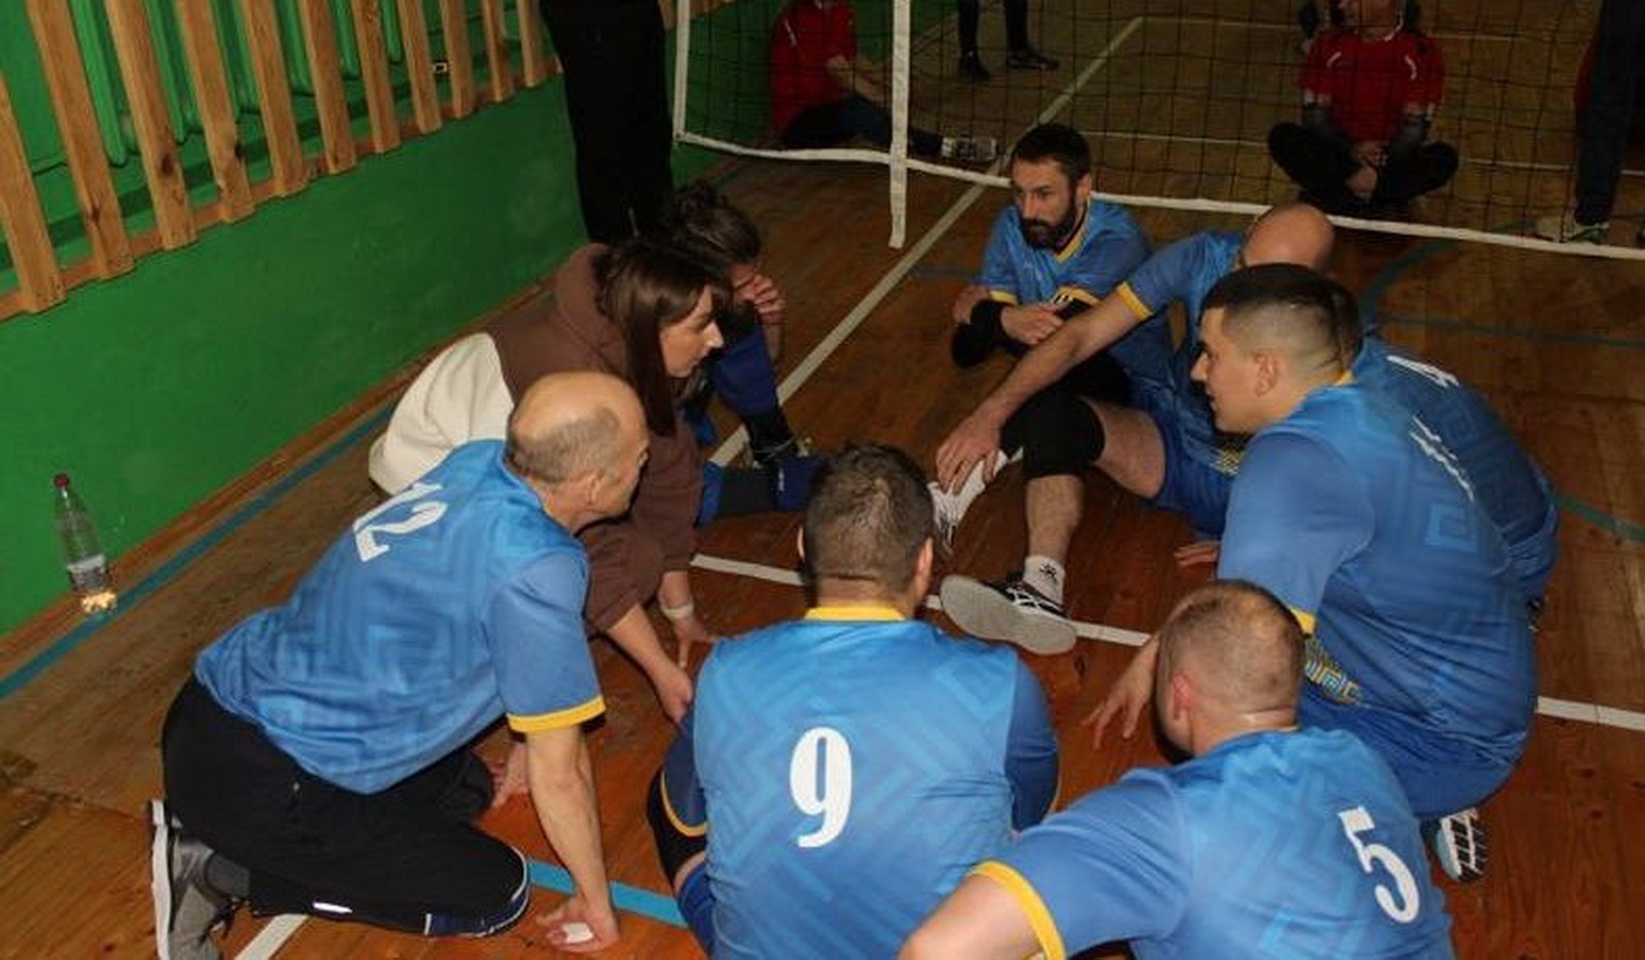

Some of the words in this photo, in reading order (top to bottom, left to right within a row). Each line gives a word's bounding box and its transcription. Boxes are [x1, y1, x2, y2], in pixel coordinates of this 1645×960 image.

[352, 482, 448, 562] 12
[789, 726, 852, 847] 9
[1337, 805, 1419, 923] 5
